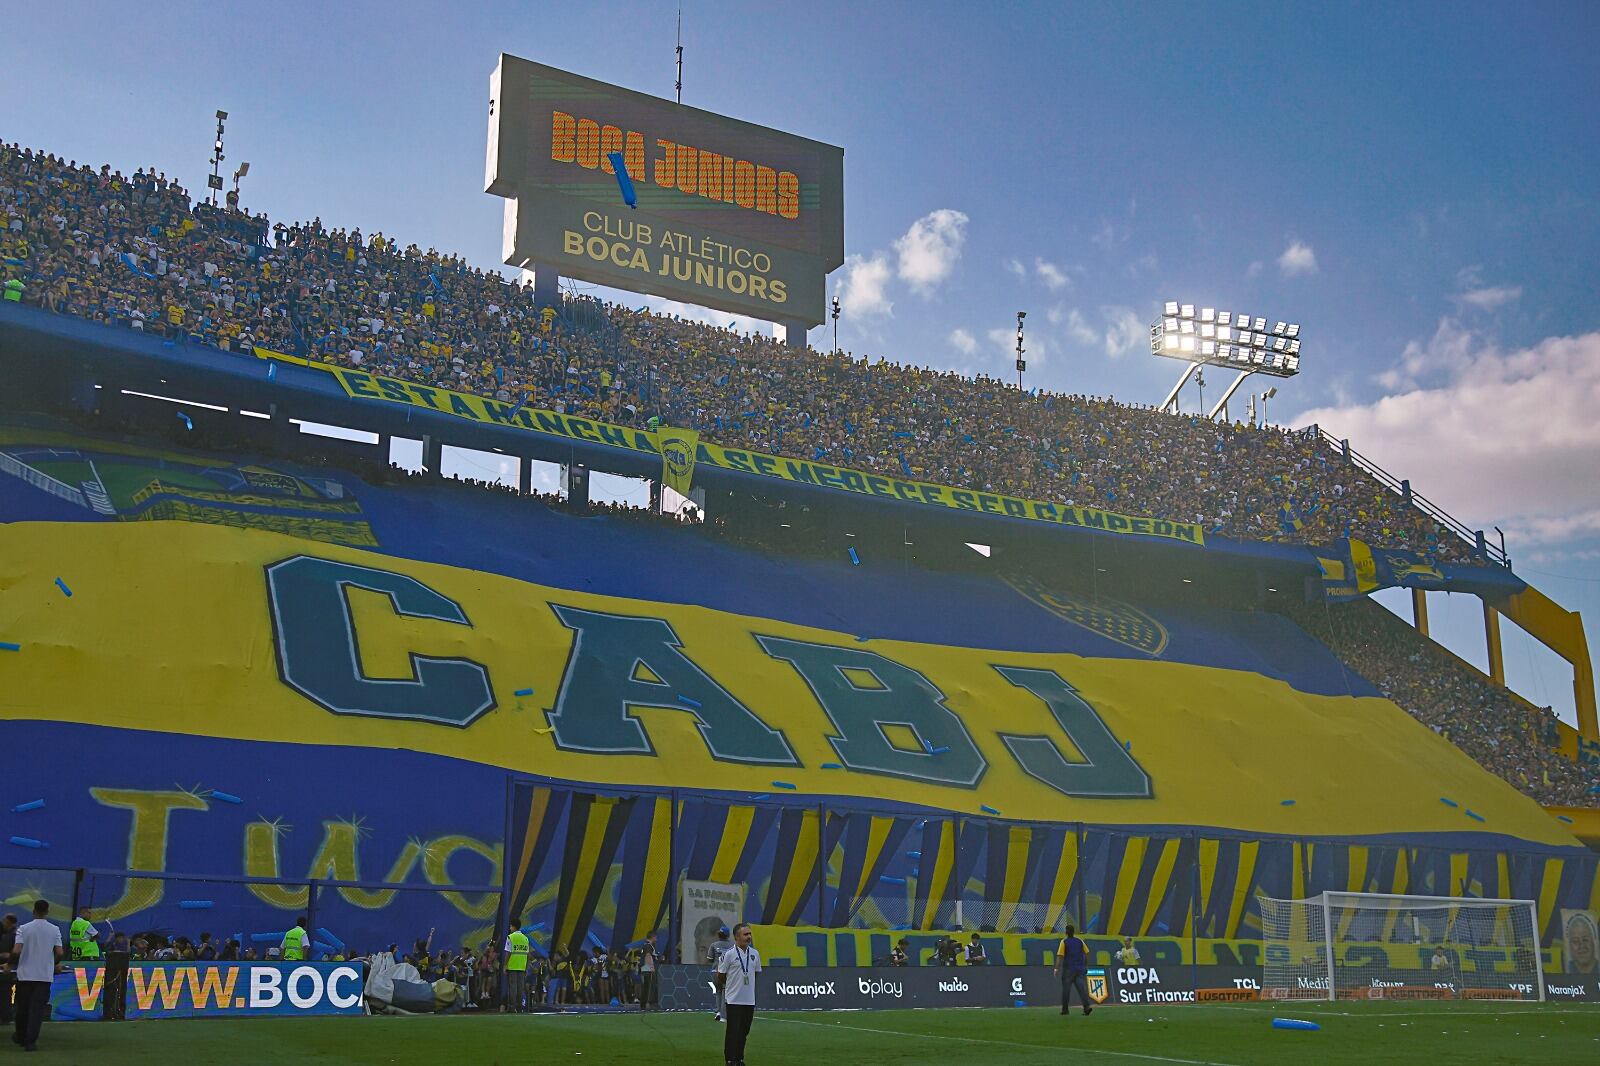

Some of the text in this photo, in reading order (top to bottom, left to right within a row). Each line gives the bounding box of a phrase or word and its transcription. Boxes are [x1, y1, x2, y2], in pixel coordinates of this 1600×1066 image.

[552, 111, 799, 220] BOCA JUNIORS
[583, 211, 771, 273] CLUB ATLÉTICO
[563, 230, 787, 303] BOCA JUNIORS
[341, 371, 480, 419] ESTA
[723, 450, 782, 477] SE
[786, 461, 949, 507] MERECE
[952, 491, 1027, 518] SER
[263, 555, 1153, 798] CABJ
[939, 976, 969, 993] Naldo
[1117, 967, 1160, 985] COPA
[1233, 978, 1261, 990] TCL
[74, 965, 364, 1011] WWW.BOC
[775, 981, 836, 998] NaranjaX
[859, 977, 903, 998] bplay
[1120, 989, 1142, 1002] Sur
[1547, 984, 1586, 998] NaranjaX
